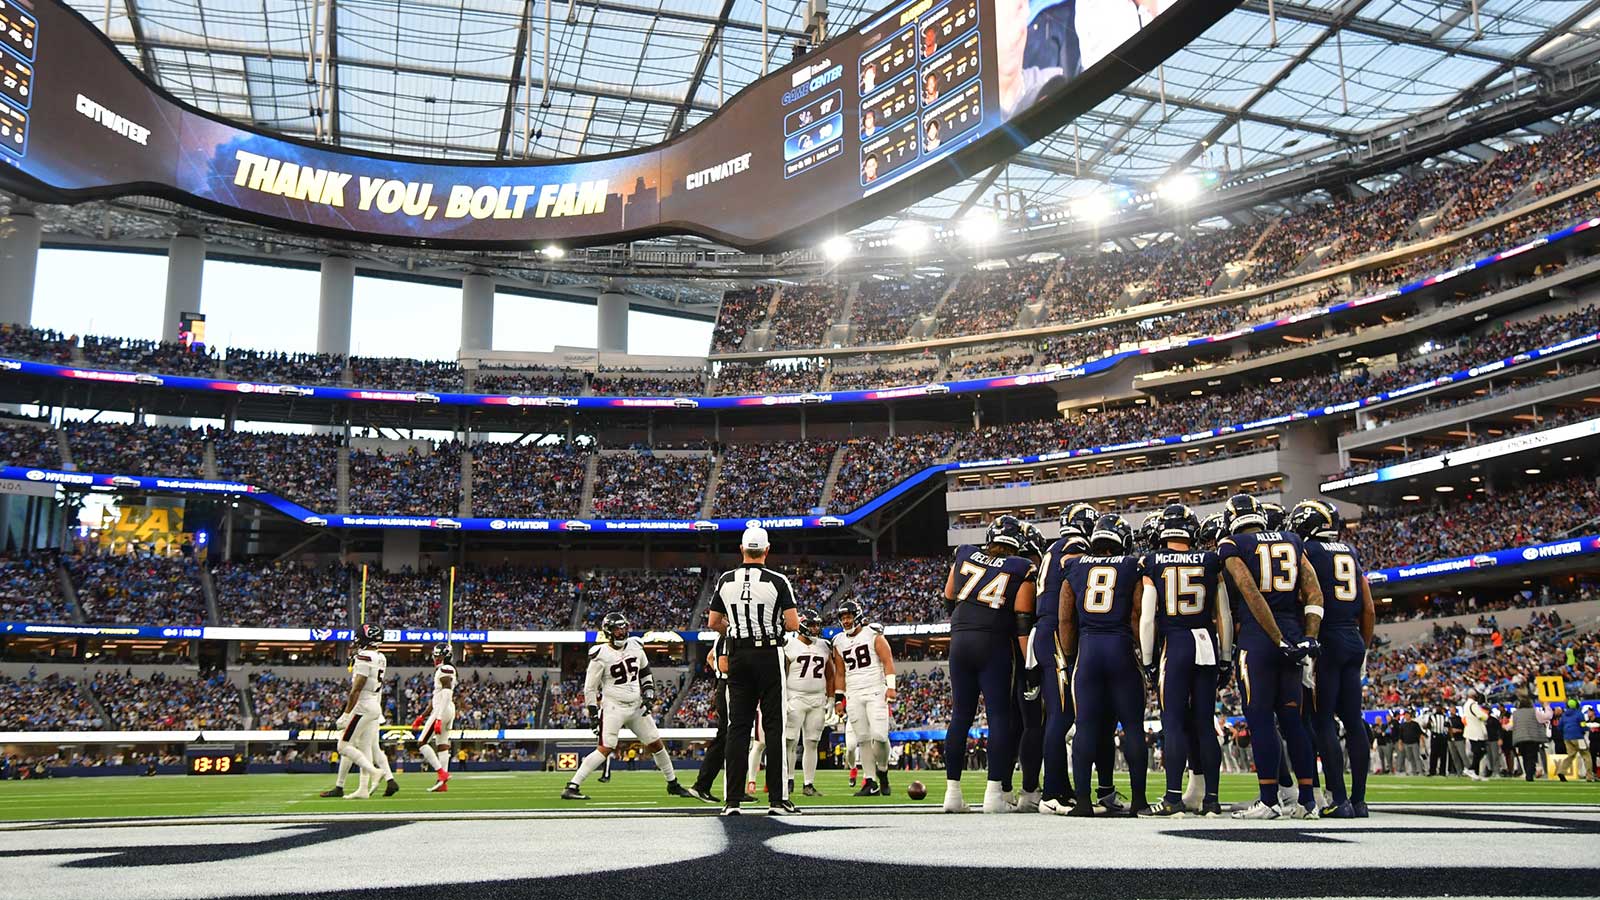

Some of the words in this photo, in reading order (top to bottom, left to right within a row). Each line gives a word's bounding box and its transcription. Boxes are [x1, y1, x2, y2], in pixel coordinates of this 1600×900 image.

[968, 8, 976, 19] 0
[907, 48, 914, 58] 0
[970, 56, 978, 67] 0
[809, 64, 844, 92] CENTER
[820, 98, 834, 115] 17
[908, 95, 916, 105] 0
[972, 105, 980, 116] 0
[75, 93, 152, 147] CUTWATER
[886, 153, 892, 163] 1
[909, 141, 917, 151] 0
[686, 153, 752, 191] CUTWATER
[233, 149, 353, 210] THANK
[356, 174, 440, 221] YOU,
[444, 183, 537, 221] BOLT
[534, 179, 610, 219] FAM
[45, 472, 94, 485] HYUNDAI
[343, 517, 355, 525] The
[507, 520, 549, 530] HYUNDAI
[606, 522, 618, 530] The
[762, 518, 803, 528] HYUNDAI
[1255, 531, 1284, 542] ALLEN
[1538, 540, 1582, 558] HYUNDAI
[1078, 554, 1124, 564] HAMPTON
[1254, 542, 1300, 593] 13
[957, 560, 1012, 610] 74
[1333, 553, 1358, 602] 9
[742, 582, 751, 590] R
[1083, 565, 1118, 614] 8
[1160, 566, 1207, 617] 15
[740, 590, 753, 604] 4
[842, 643, 872, 672] 58
[609, 656, 639, 686] 95
[796, 654, 825, 679] 72
[1542, 680, 1560, 697] 11
[193, 756, 231, 772] 13:13
[558, 754, 578, 769] 25
